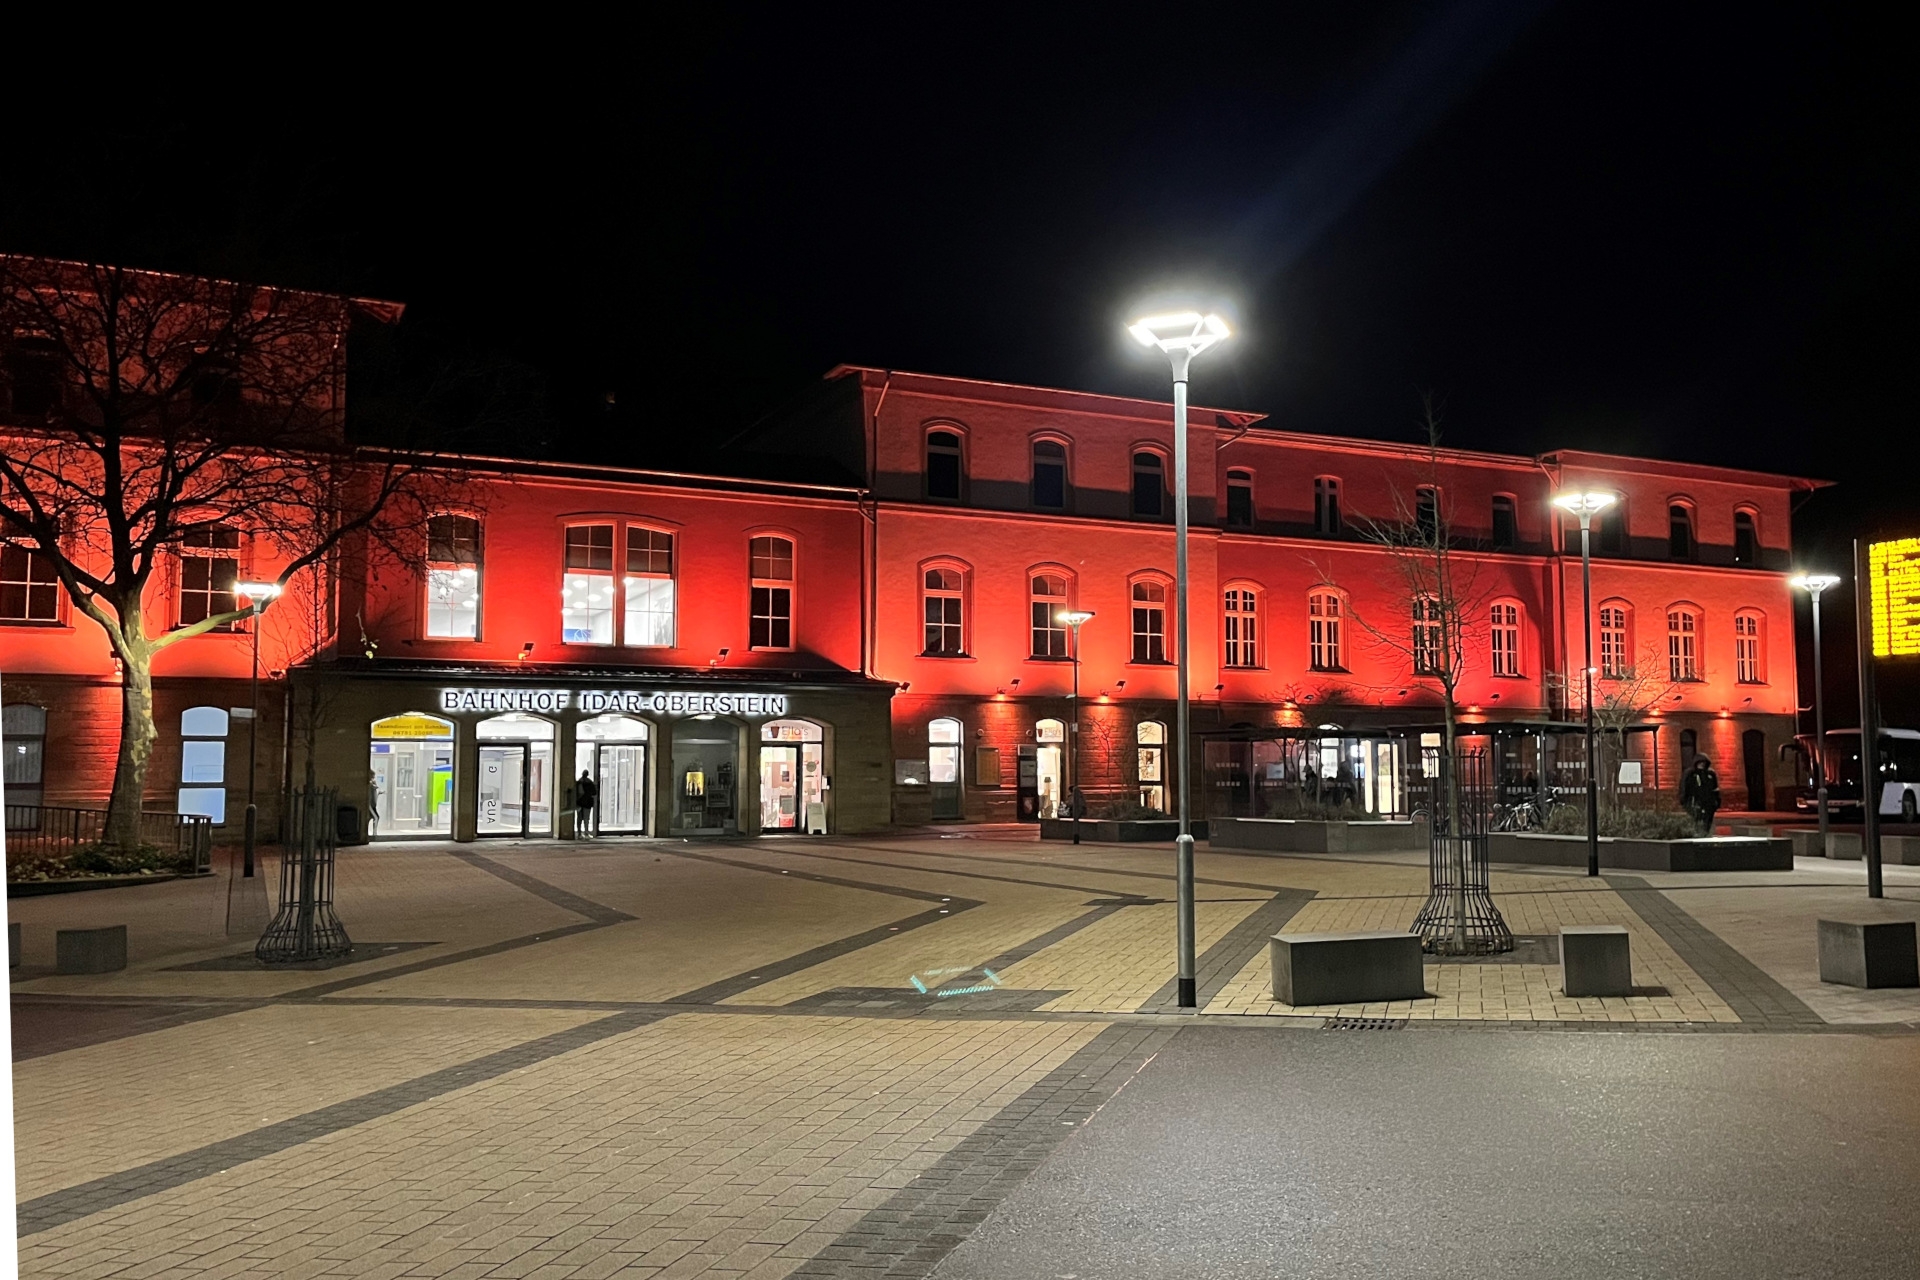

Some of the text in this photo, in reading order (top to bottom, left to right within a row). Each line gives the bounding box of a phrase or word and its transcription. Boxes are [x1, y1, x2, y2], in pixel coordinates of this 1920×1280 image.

[444, 691, 785, 714] BAHNHOF IDAR-OBERSTEIN
[781, 725, 809, 736] Ella's
